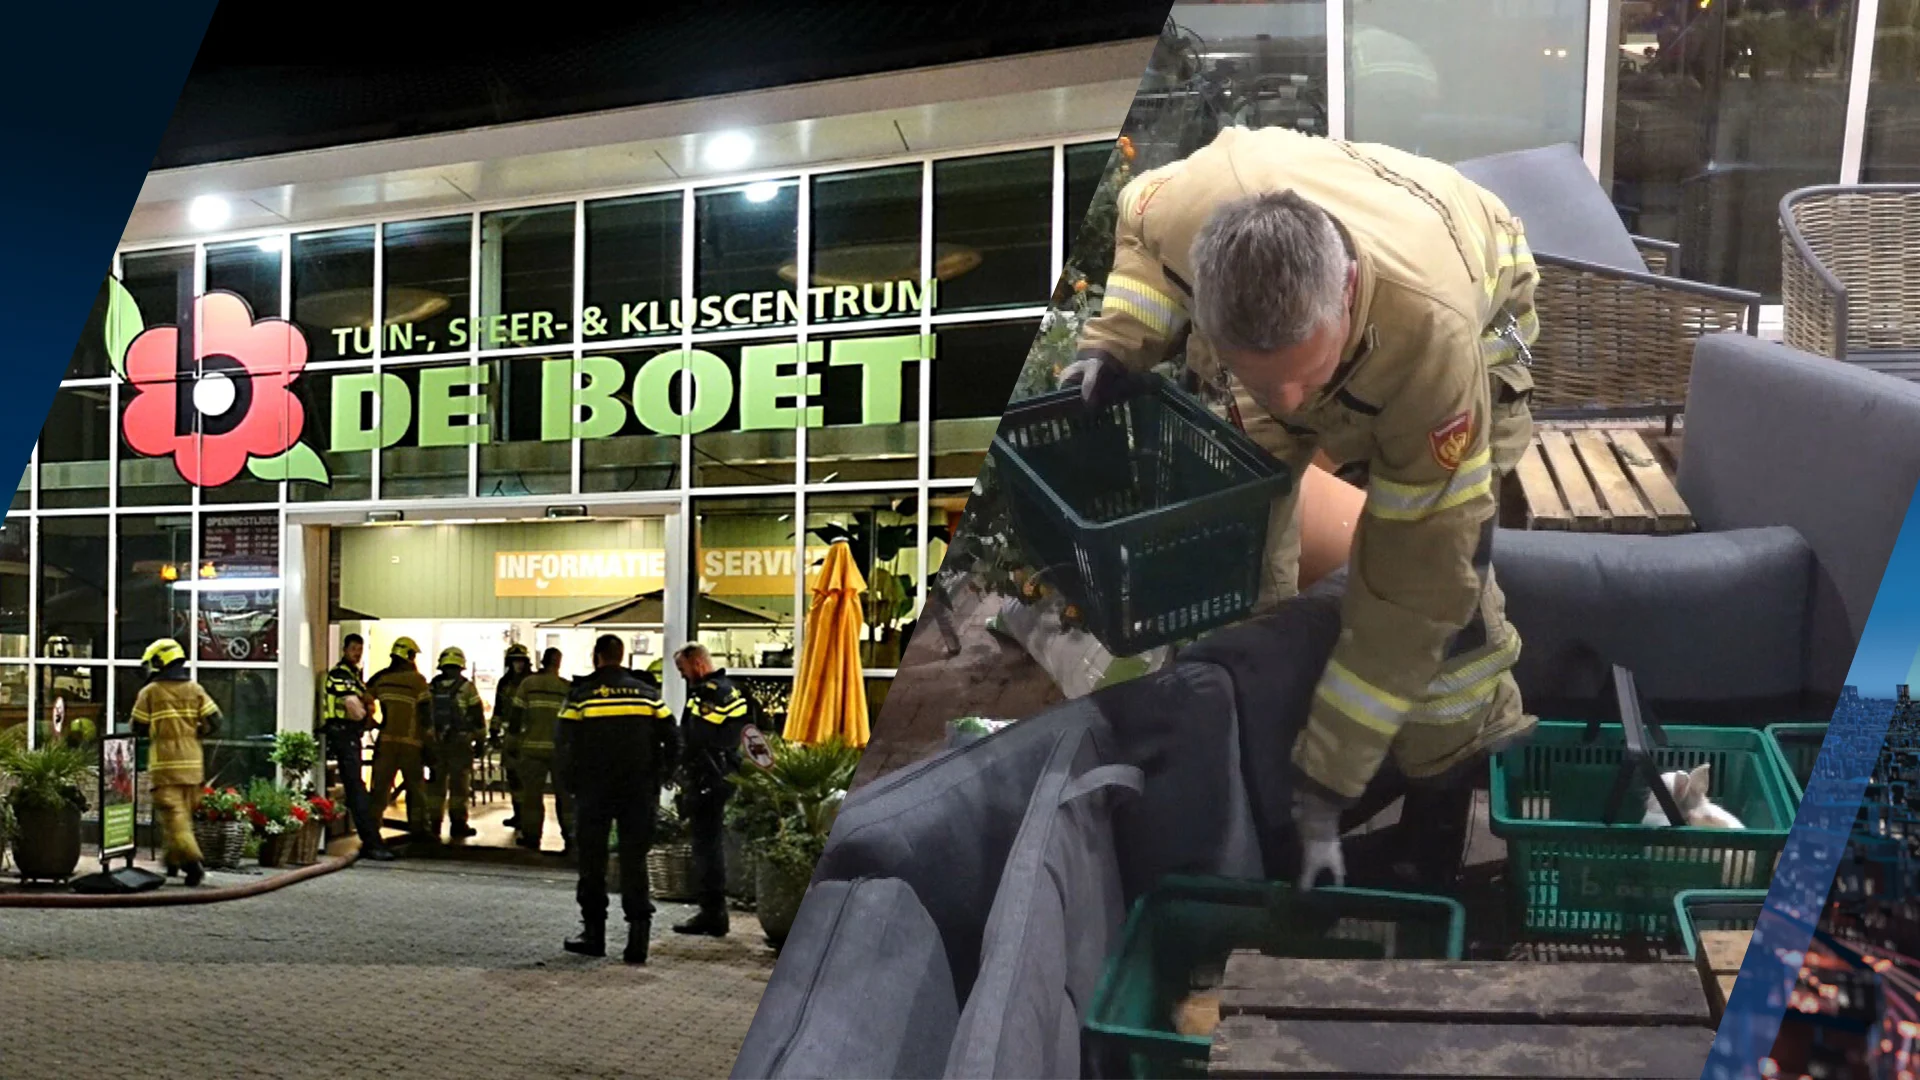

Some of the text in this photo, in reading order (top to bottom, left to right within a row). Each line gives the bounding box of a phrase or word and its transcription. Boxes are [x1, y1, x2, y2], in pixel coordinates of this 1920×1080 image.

[332, 279, 939, 356] TUIN-, SFEER- & KLUSCENTRUM
[330, 333, 938, 453] DE BOET
[500, 553, 665, 578] INFORMATIE
